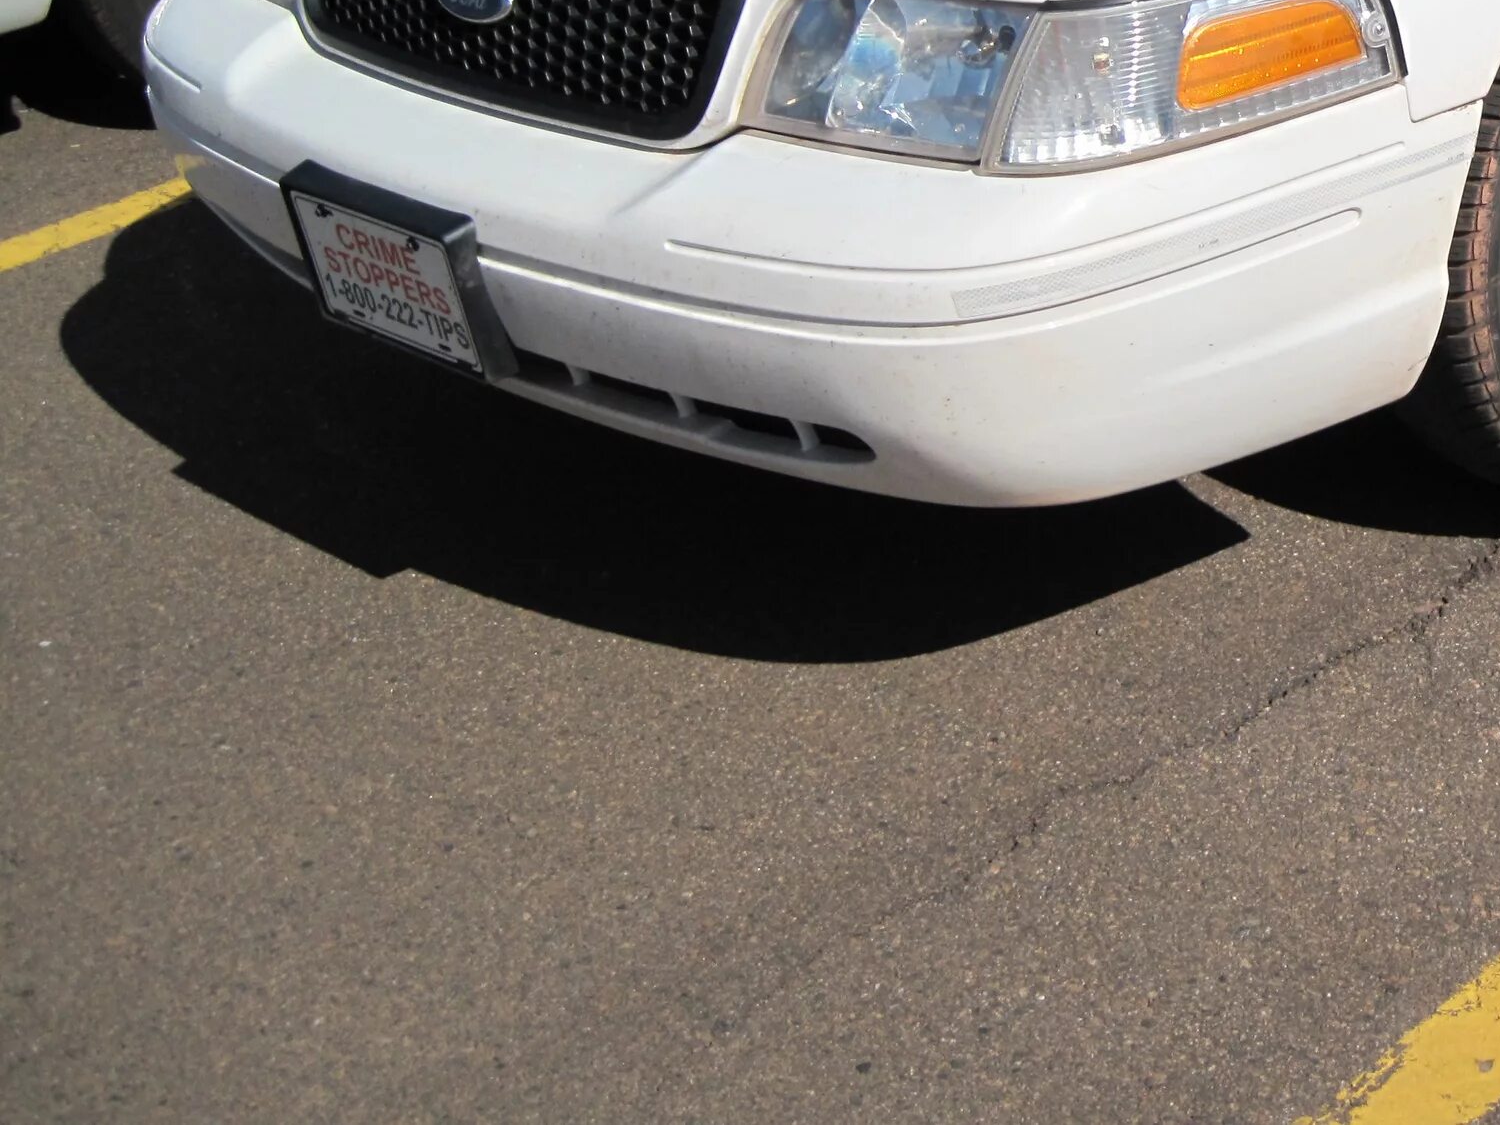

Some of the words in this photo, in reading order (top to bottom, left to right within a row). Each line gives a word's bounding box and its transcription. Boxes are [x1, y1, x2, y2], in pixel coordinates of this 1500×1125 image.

[324, 246, 452, 315] STOPPERS
[336, 224, 420, 274] CRIME
[326, 273, 470, 350] 1-800-222-TIPS
